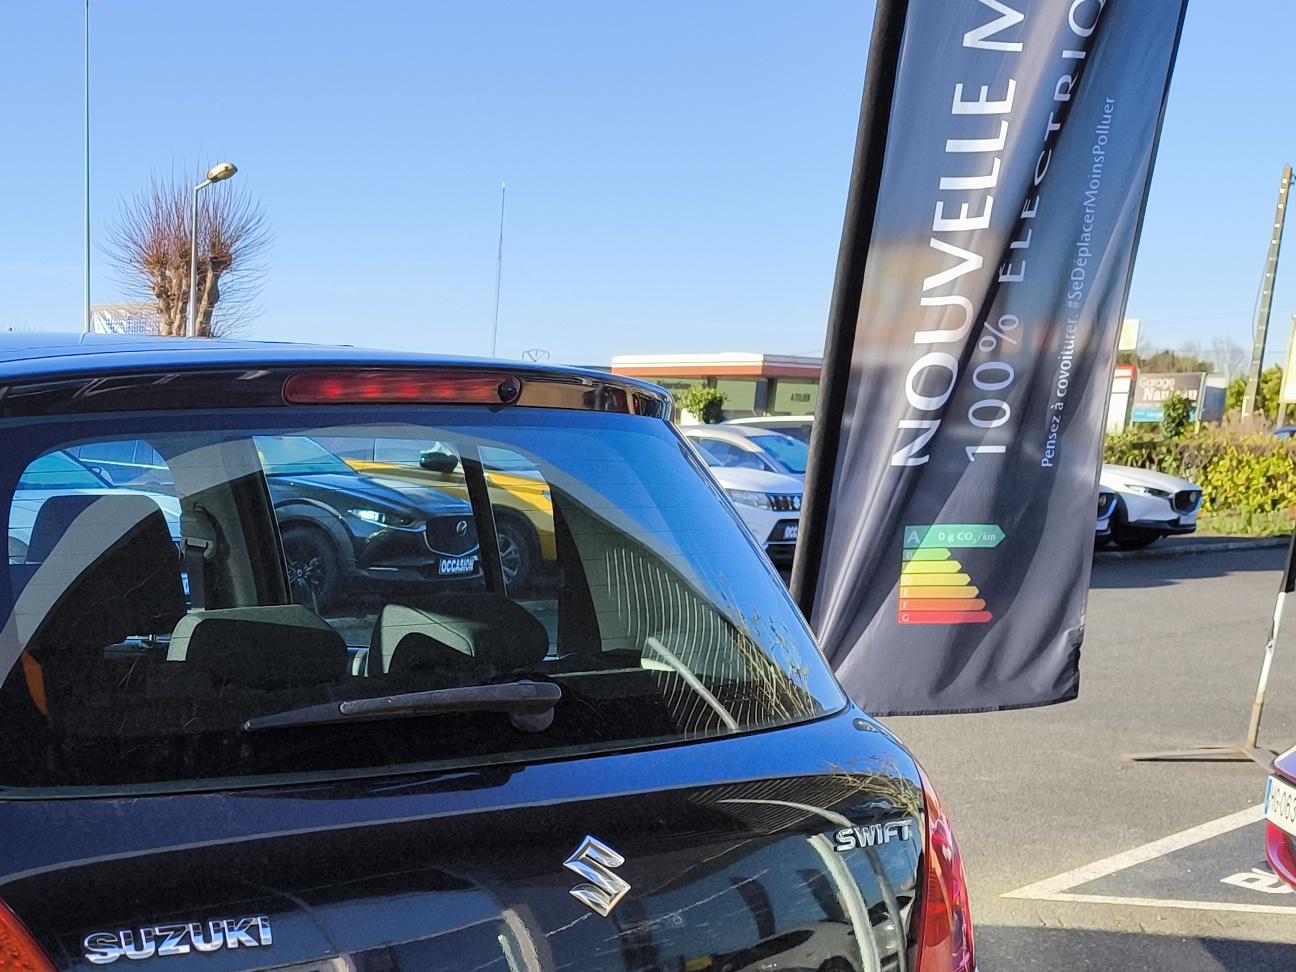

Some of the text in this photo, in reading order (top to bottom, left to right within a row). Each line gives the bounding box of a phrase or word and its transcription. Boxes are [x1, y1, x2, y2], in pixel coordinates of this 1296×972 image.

[1067, 98, 1116, 309] #SeDéplacerMoinsPolluer
[890, 0, 1025, 467] NOUVELLE M
[965, 313, 1019, 462] 100%
[1050, 401, 1064, 412] à
[1041, 415, 1061, 467] Pensez
[907, 530, 921, 544] A
[938, 531, 946, 541] 0
[835, 819, 913, 852] SWIFT
[84, 916, 273, 965] SUZUKI
